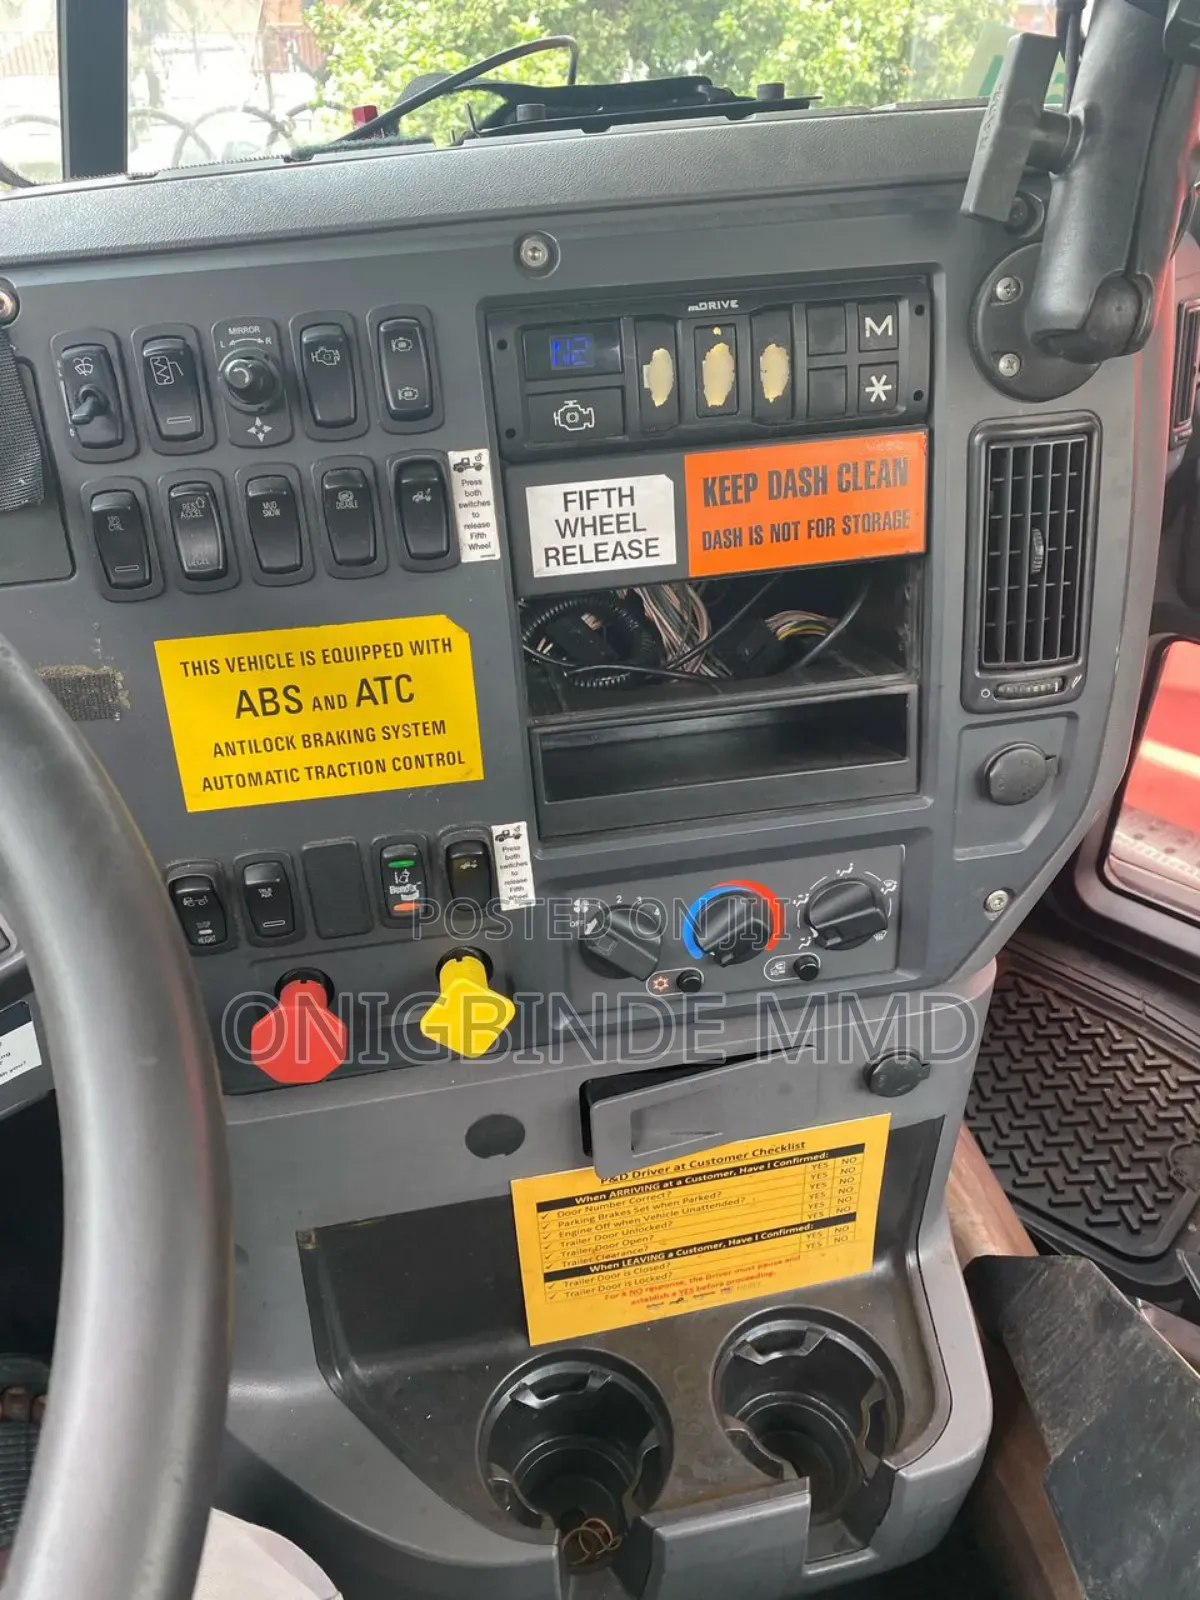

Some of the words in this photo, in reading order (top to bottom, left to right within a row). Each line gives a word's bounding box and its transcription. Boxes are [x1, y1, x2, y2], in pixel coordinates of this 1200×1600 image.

[219, 340, 226, 348] L
[265, 336, 272, 345] R
[228, 325, 260, 335] MIRROR
[865, 315, 893, 337] M
[461, 479, 482, 487] Press
[563, 485, 635, 513] FIFTH
[703, 473, 758, 508] KEEP
[768, 465, 829, 501] DASH
[837, 456, 909, 493] CLEAN
[458, 500, 491, 509] switches
[463, 522, 491, 530] release
[469, 532, 487, 540] Fifth
[555, 515, 647, 540] WHEEL
[702, 527, 742, 551] DASH
[748, 524, 764, 545] IS
[770, 521, 800, 544] NOT
[807, 517, 836, 540] FOR
[842, 508, 911, 536] STORAGE
[468, 541, 491, 551] Wheel
[544, 537, 661, 569] RELEASE
[180, 659, 220, 677] THIS
[225, 652, 294, 673] VEHICLE
[300, 650, 316, 667] IS
[322, 642, 404, 665] EQUIPPED
[409, 637, 452, 656] WITH
[235, 684, 303, 719] ABS
[312, 694, 348, 712] AND
[356, 673, 415, 708] ATC
[212, 735, 297, 758] ANTILOCK
[301, 727, 376, 750] BRAKING
[382, 719, 447, 741] SYSTEM
[202, 767, 300, 792] AUTOMATIC
[304, 758, 387, 782] TRACTION
[391, 750, 466, 771] CONTROL
[615, 895, 622, 904] 2
[574, 1193, 607, 1205] When
[608, 1182, 661, 1201] ARRIVING
[663, 1180, 674, 1189] at
[684, 1169, 737, 1185] Customer,
[739, 1162, 765, 1174] Have
[773, 1152, 829, 1168] Confirmed:
[632, 1164, 671, 1180] Driver
[674, 1161, 686, 1171] at
[689, 1151, 748, 1168] Customer
[752, 1141, 806, 1157] Checklist
[557, 1208, 581, 1218] Door
[585, 1198, 626, 1212] Number
[629, 1190, 673, 1204] Correct?
[842, 1157, 857, 1165] NO
[558, 1216, 595, 1228] Parking
[598, 1209, 631, 1221] Brakes
[634, 1205, 650, 1213] Set
[652, 1199, 680, 1210] when
[682, 1191, 723, 1204] Parked?
[811, 1172, 828, 1180] YES
[840, 1167, 856, 1175] NO
[559, 1227, 592, 1239] Engine
[595, 1221, 612, 1231] Off
[613, 1217, 641, 1228] when
[643, 1207, 679, 1221] Vehicle
[682, 1197, 746, 1214] Unattended?
[809, 1182, 827, 1190] YES
[839, 1177, 855, 1185] NO
[560, 1237, 594, 1248] Trailer
[594, 1233, 618, 1241] Door
[622, 1221, 673, 1236] Unlocked?
[808, 1192, 826, 1200] YES
[838, 1186, 854, 1194] NO
[561, 1247, 594, 1257] Trailer
[595, 1241, 619, 1251] Door
[622, 1234, 655, 1246] Open?
[808, 1202, 825, 1210] YES
[837, 1196, 853, 1204] NO
[562, 1256, 592, 1267] Trailer
[596, 1245, 649, 1260] Clearance?
[807, 1211, 825, 1220] YES
[835, 1206, 851, 1214] NO
[589, 1263, 620, 1273] When
[622, 1253, 665, 1267] LEAVING
[676, 1241, 726, 1256] Customer,
[728, 1236, 753, 1246] Have
[761, 1223, 814, 1240] Confirmed:
[564, 1277, 594, 1288] Trailer
[597, 1273, 620, 1281] Door
[623, 1268, 631, 1276] is
[633, 1262, 671, 1274] Closed?
[806, 1231, 823, 1239] YES
[834, 1225, 850, 1234] NO
[565, 1287, 595, 1298] Trailer
[598, 1283, 621, 1291] Door
[624, 1278, 632, 1287] is
[634, 1271, 673, 1285] Locked?
[805, 1241, 823, 1250] YES
[833, 1235, 849, 1244] NO
[605, 1292, 619, 1301] For
[629, 1288, 643, 1297] NO
[689, 1275, 703, 1284] the
[705, 1269, 731, 1281] Driver
[734, 1265, 756, 1274] must
[631, 1292, 670, 1306] establish
[679, 1287, 694, 1296] YES
[696, 1281, 724, 1293] before
